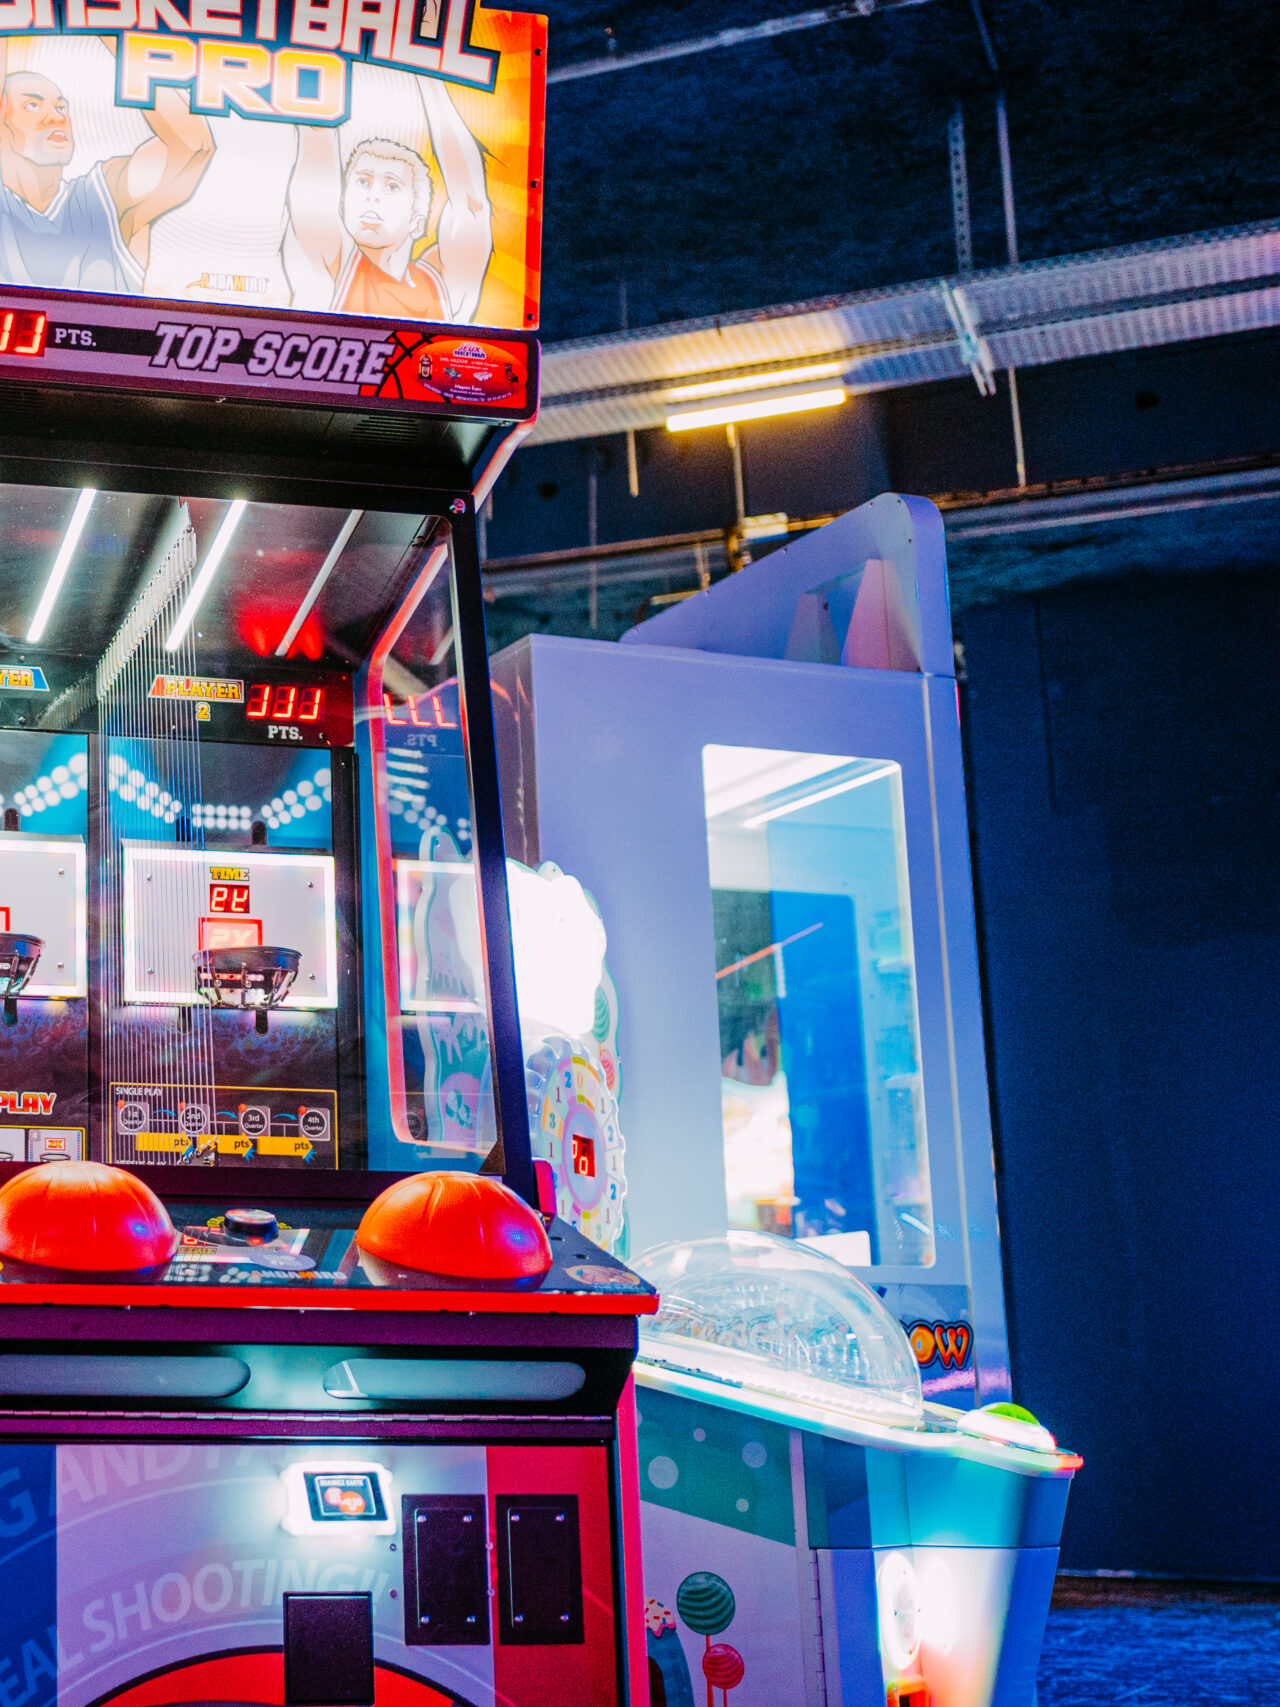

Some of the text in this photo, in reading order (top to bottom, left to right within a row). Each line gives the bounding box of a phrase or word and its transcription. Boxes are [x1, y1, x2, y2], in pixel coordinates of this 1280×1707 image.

[120, 29, 349, 121] PRO
[54, 327, 97, 348] PTS.
[150, 322, 396, 385] TOP SCORE
[165, 678, 241, 700] PLAYER
[196, 702, 210, 721] 2
[268, 725, 303, 740] PTS.
[210, 867, 250, 881] TIME
[564, 1071, 571, 1088] 2
[115, 1087, 163, 1097] SINGLE PLAY
[248, 1114, 260, 1122] 3rd
[307, 1115, 320, 1124] 4th
[549, 1112, 556, 1129] 3
[244, 1122, 264, 1130] Quarter
[303, 1124, 323, 1132] Quarter
[608, 1125, 614, 1142] 2
[47, 1140, 63, 1149] 2X
[174, 1137, 190, 1148] pts
[234, 1138, 250, 1149] pts
[294, 1140, 310, 1151] pts
[610, 1184, 617, 1200] 2
